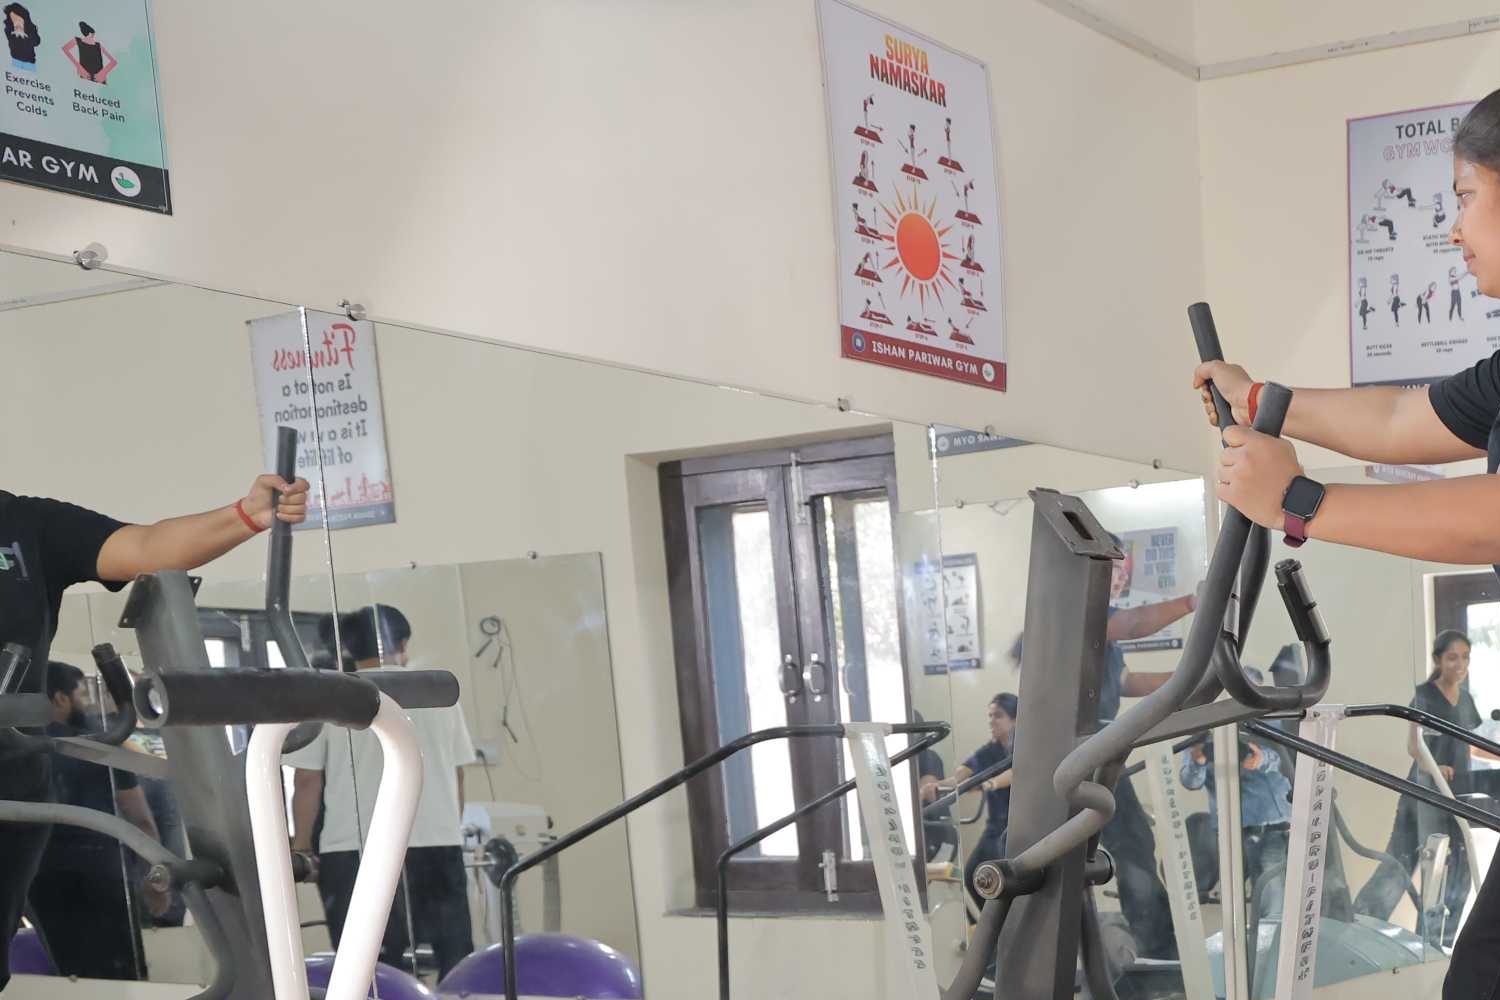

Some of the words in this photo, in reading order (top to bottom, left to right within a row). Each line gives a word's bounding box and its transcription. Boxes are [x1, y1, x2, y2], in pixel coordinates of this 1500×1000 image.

[884, 33, 929, 76] SURYA
[5, 71, 51, 92] Exercise
[869, 54, 947, 107] NAMASKAR
[5, 85, 55, 106] Prevents
[73, 89, 121, 109] Reduced
[16, 101, 48, 117] Colds
[72, 102, 99, 117] Back
[102, 108, 125, 123] Pain
[1395, 119, 1446, 140] TOTAL
[41, 156, 99, 184] GYM
[872, 341, 906, 358] ISHAN
[908, 349, 953, 370] PARIWAR
[955, 360, 978, 376] GYM
